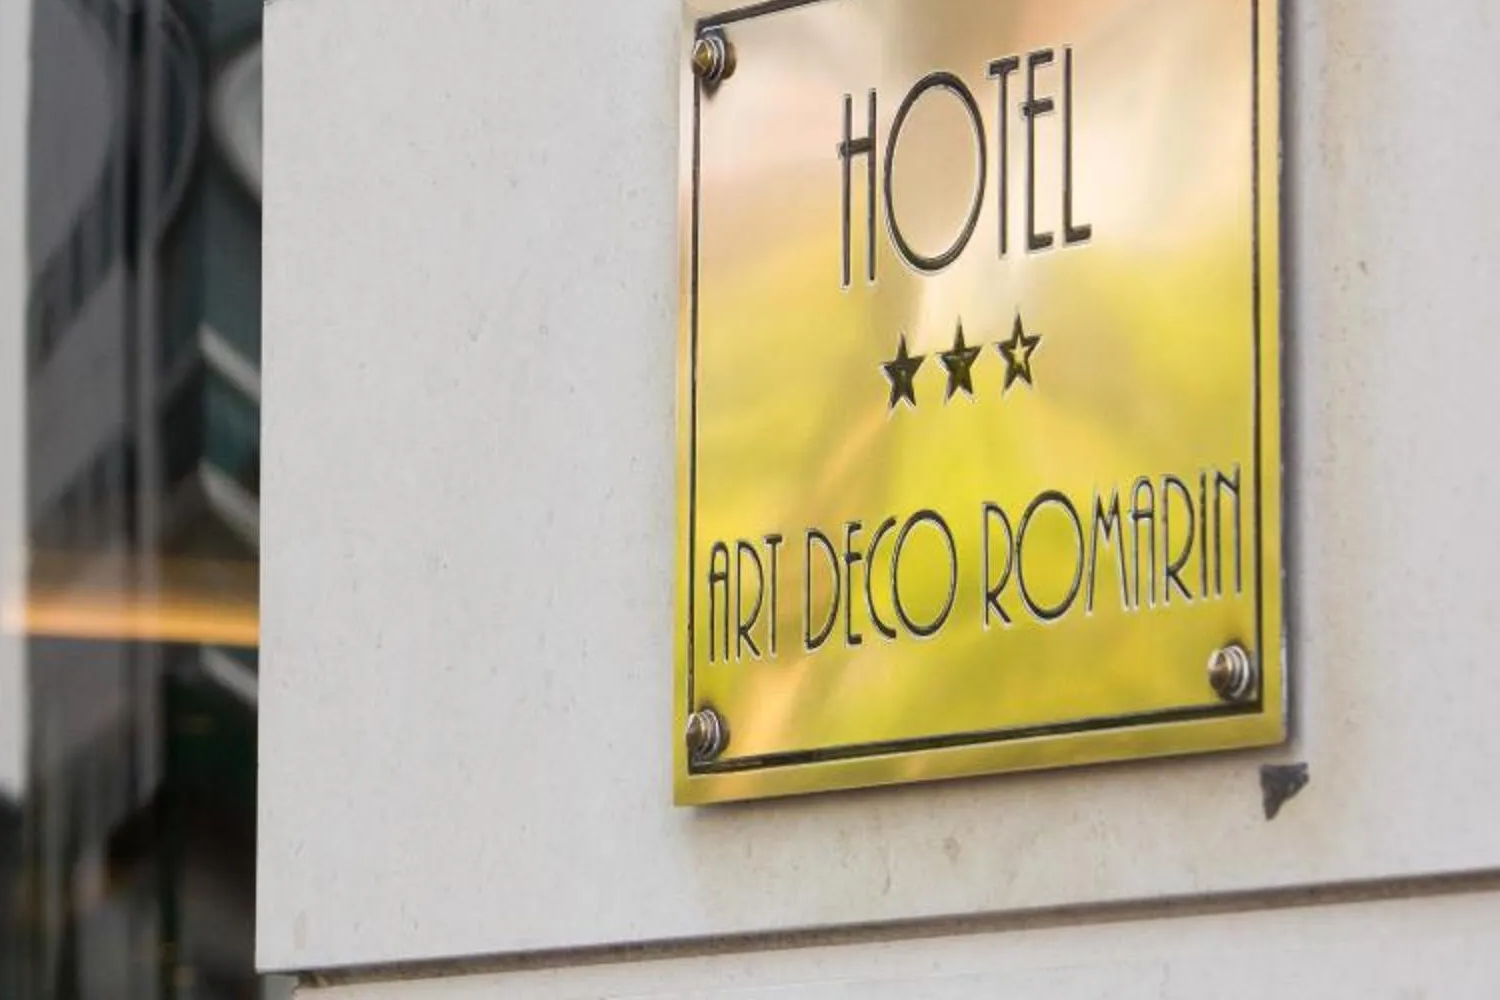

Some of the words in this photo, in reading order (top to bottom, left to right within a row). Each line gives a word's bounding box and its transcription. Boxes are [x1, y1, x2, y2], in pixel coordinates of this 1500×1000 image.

[837, 44, 1092, 289] HOTEL
[707, 534, 783, 663] ART
[803, 509, 958, 651] DECO
[981, 464, 1242, 629] ROMARIN
